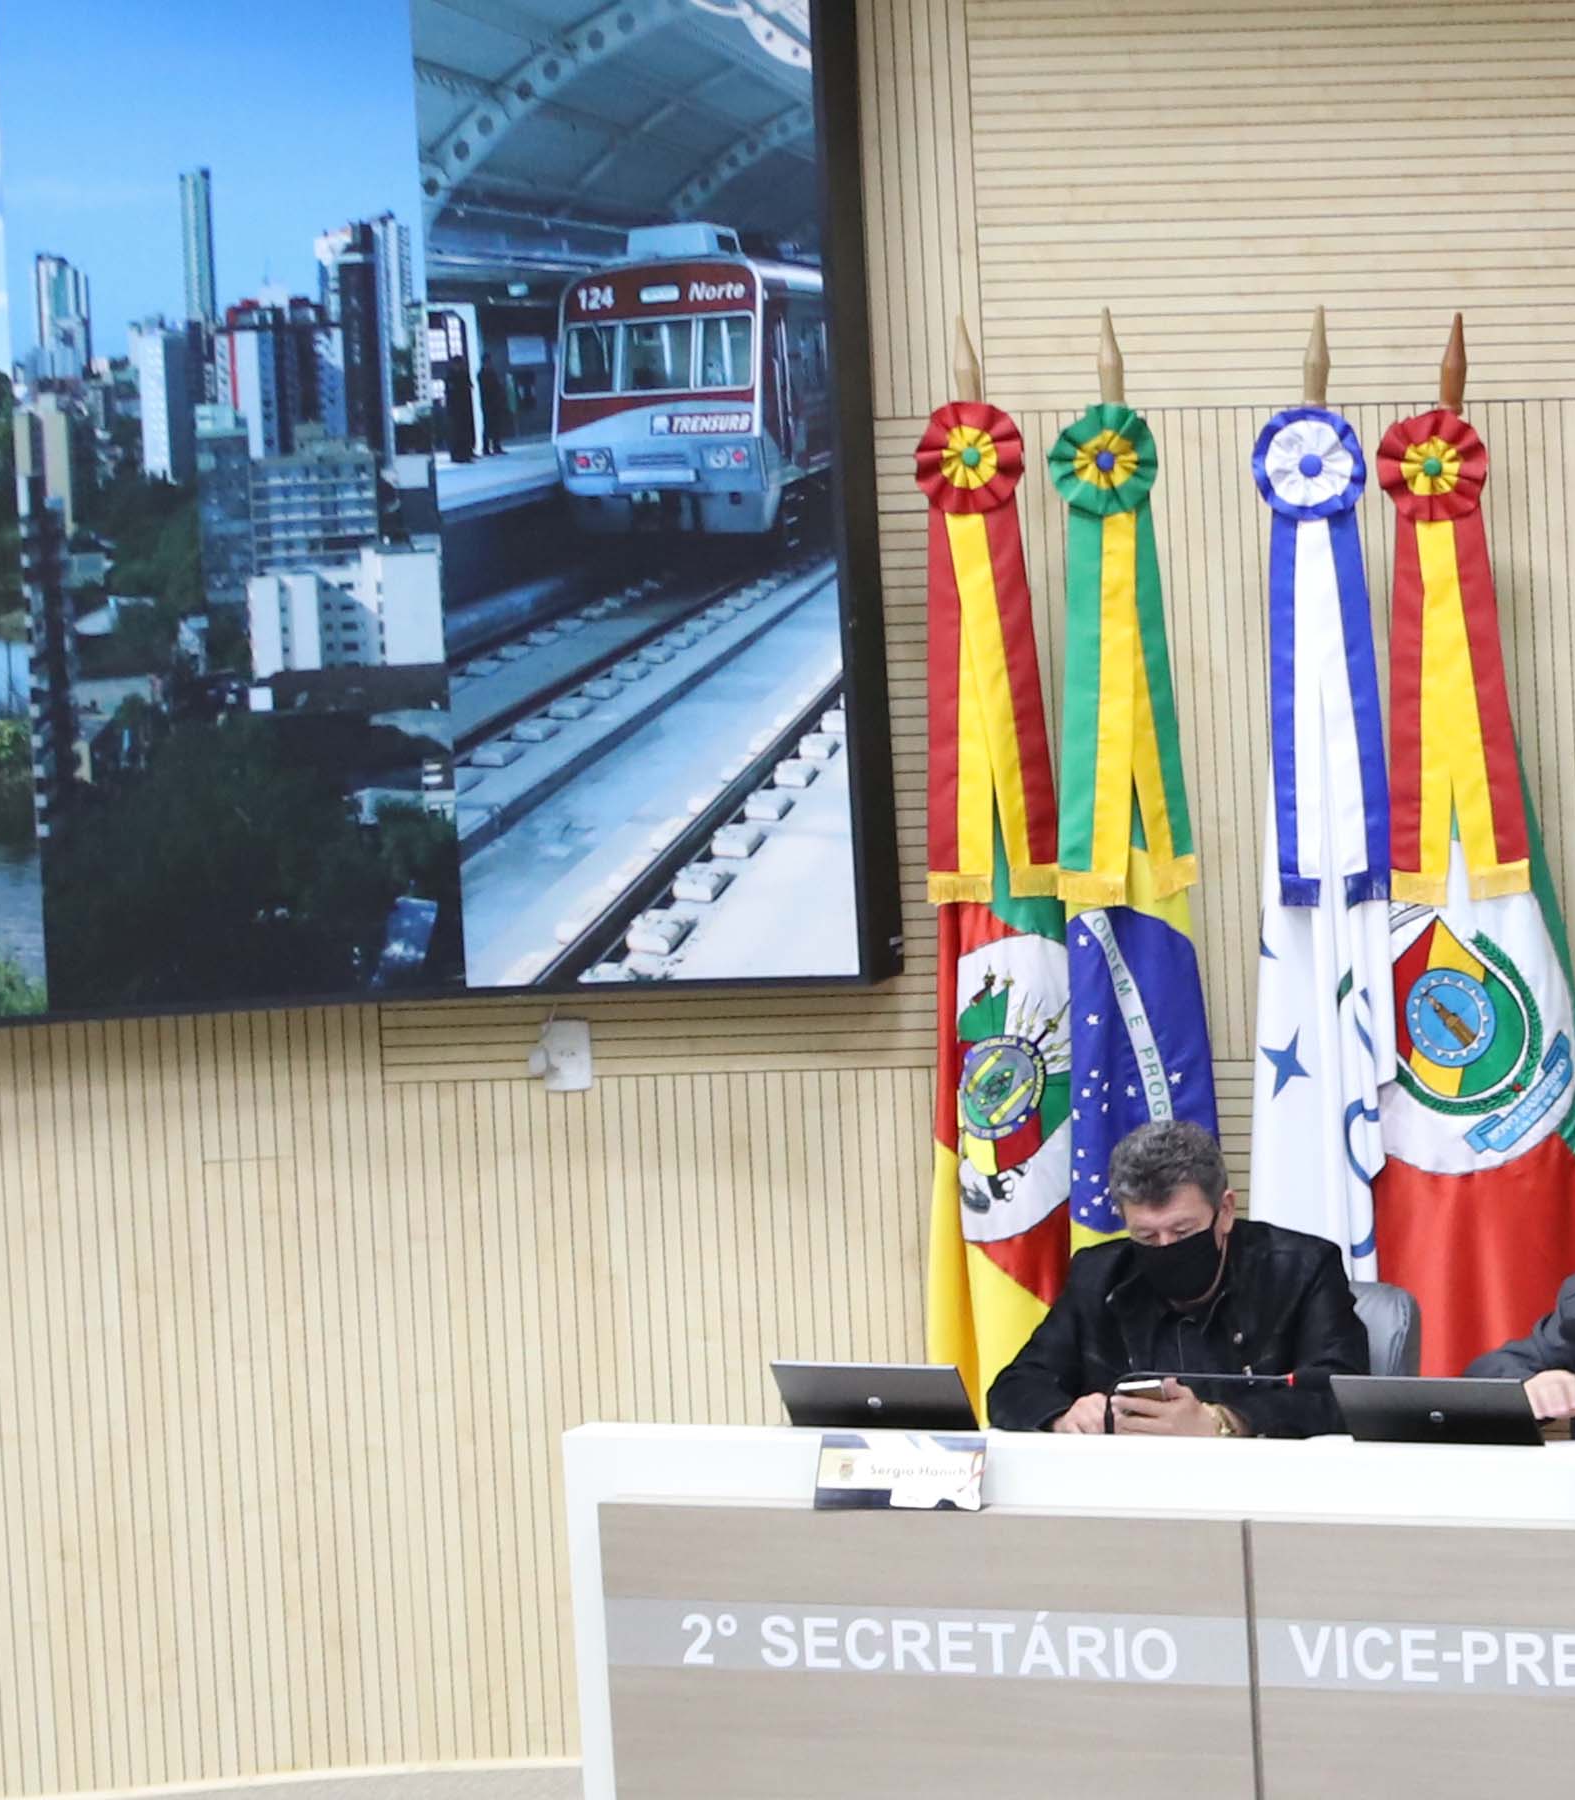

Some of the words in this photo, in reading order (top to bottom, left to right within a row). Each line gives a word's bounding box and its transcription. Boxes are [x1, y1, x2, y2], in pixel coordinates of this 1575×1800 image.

[577, 286, 615, 311] 124
[688, 281, 746, 302] Norte
[671, 414, 751, 433] TRENSURB
[1092, 917, 1134, 998] ORDEM
[1128, 1014, 1144, 1029] E
[1139, 1047, 1167, 1117] PROG
[760, 1610, 1178, 1681] SECRETÁRIO
